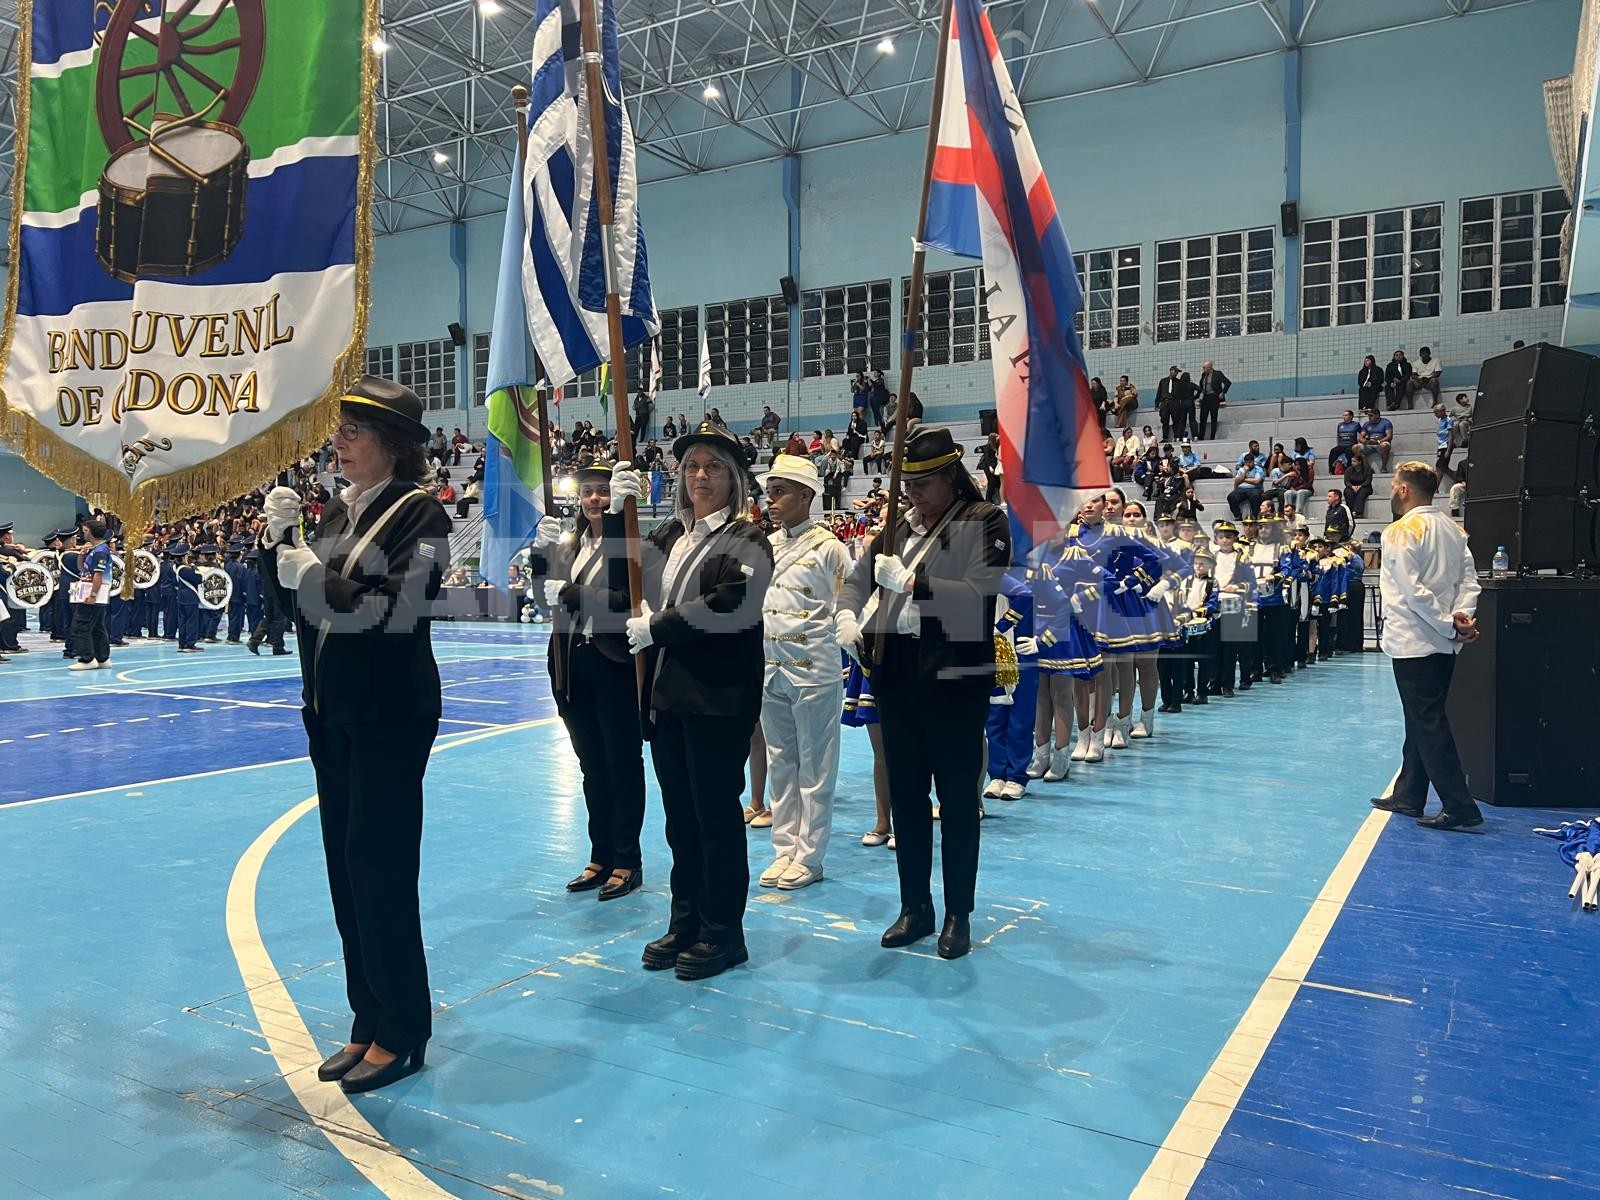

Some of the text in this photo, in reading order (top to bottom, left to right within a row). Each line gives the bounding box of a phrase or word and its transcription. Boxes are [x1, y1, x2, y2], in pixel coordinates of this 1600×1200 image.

[56, 385, 104, 427] DE
[134, 566, 153, 582] EBERI
[16, 584, 48, 598] SEBERI
